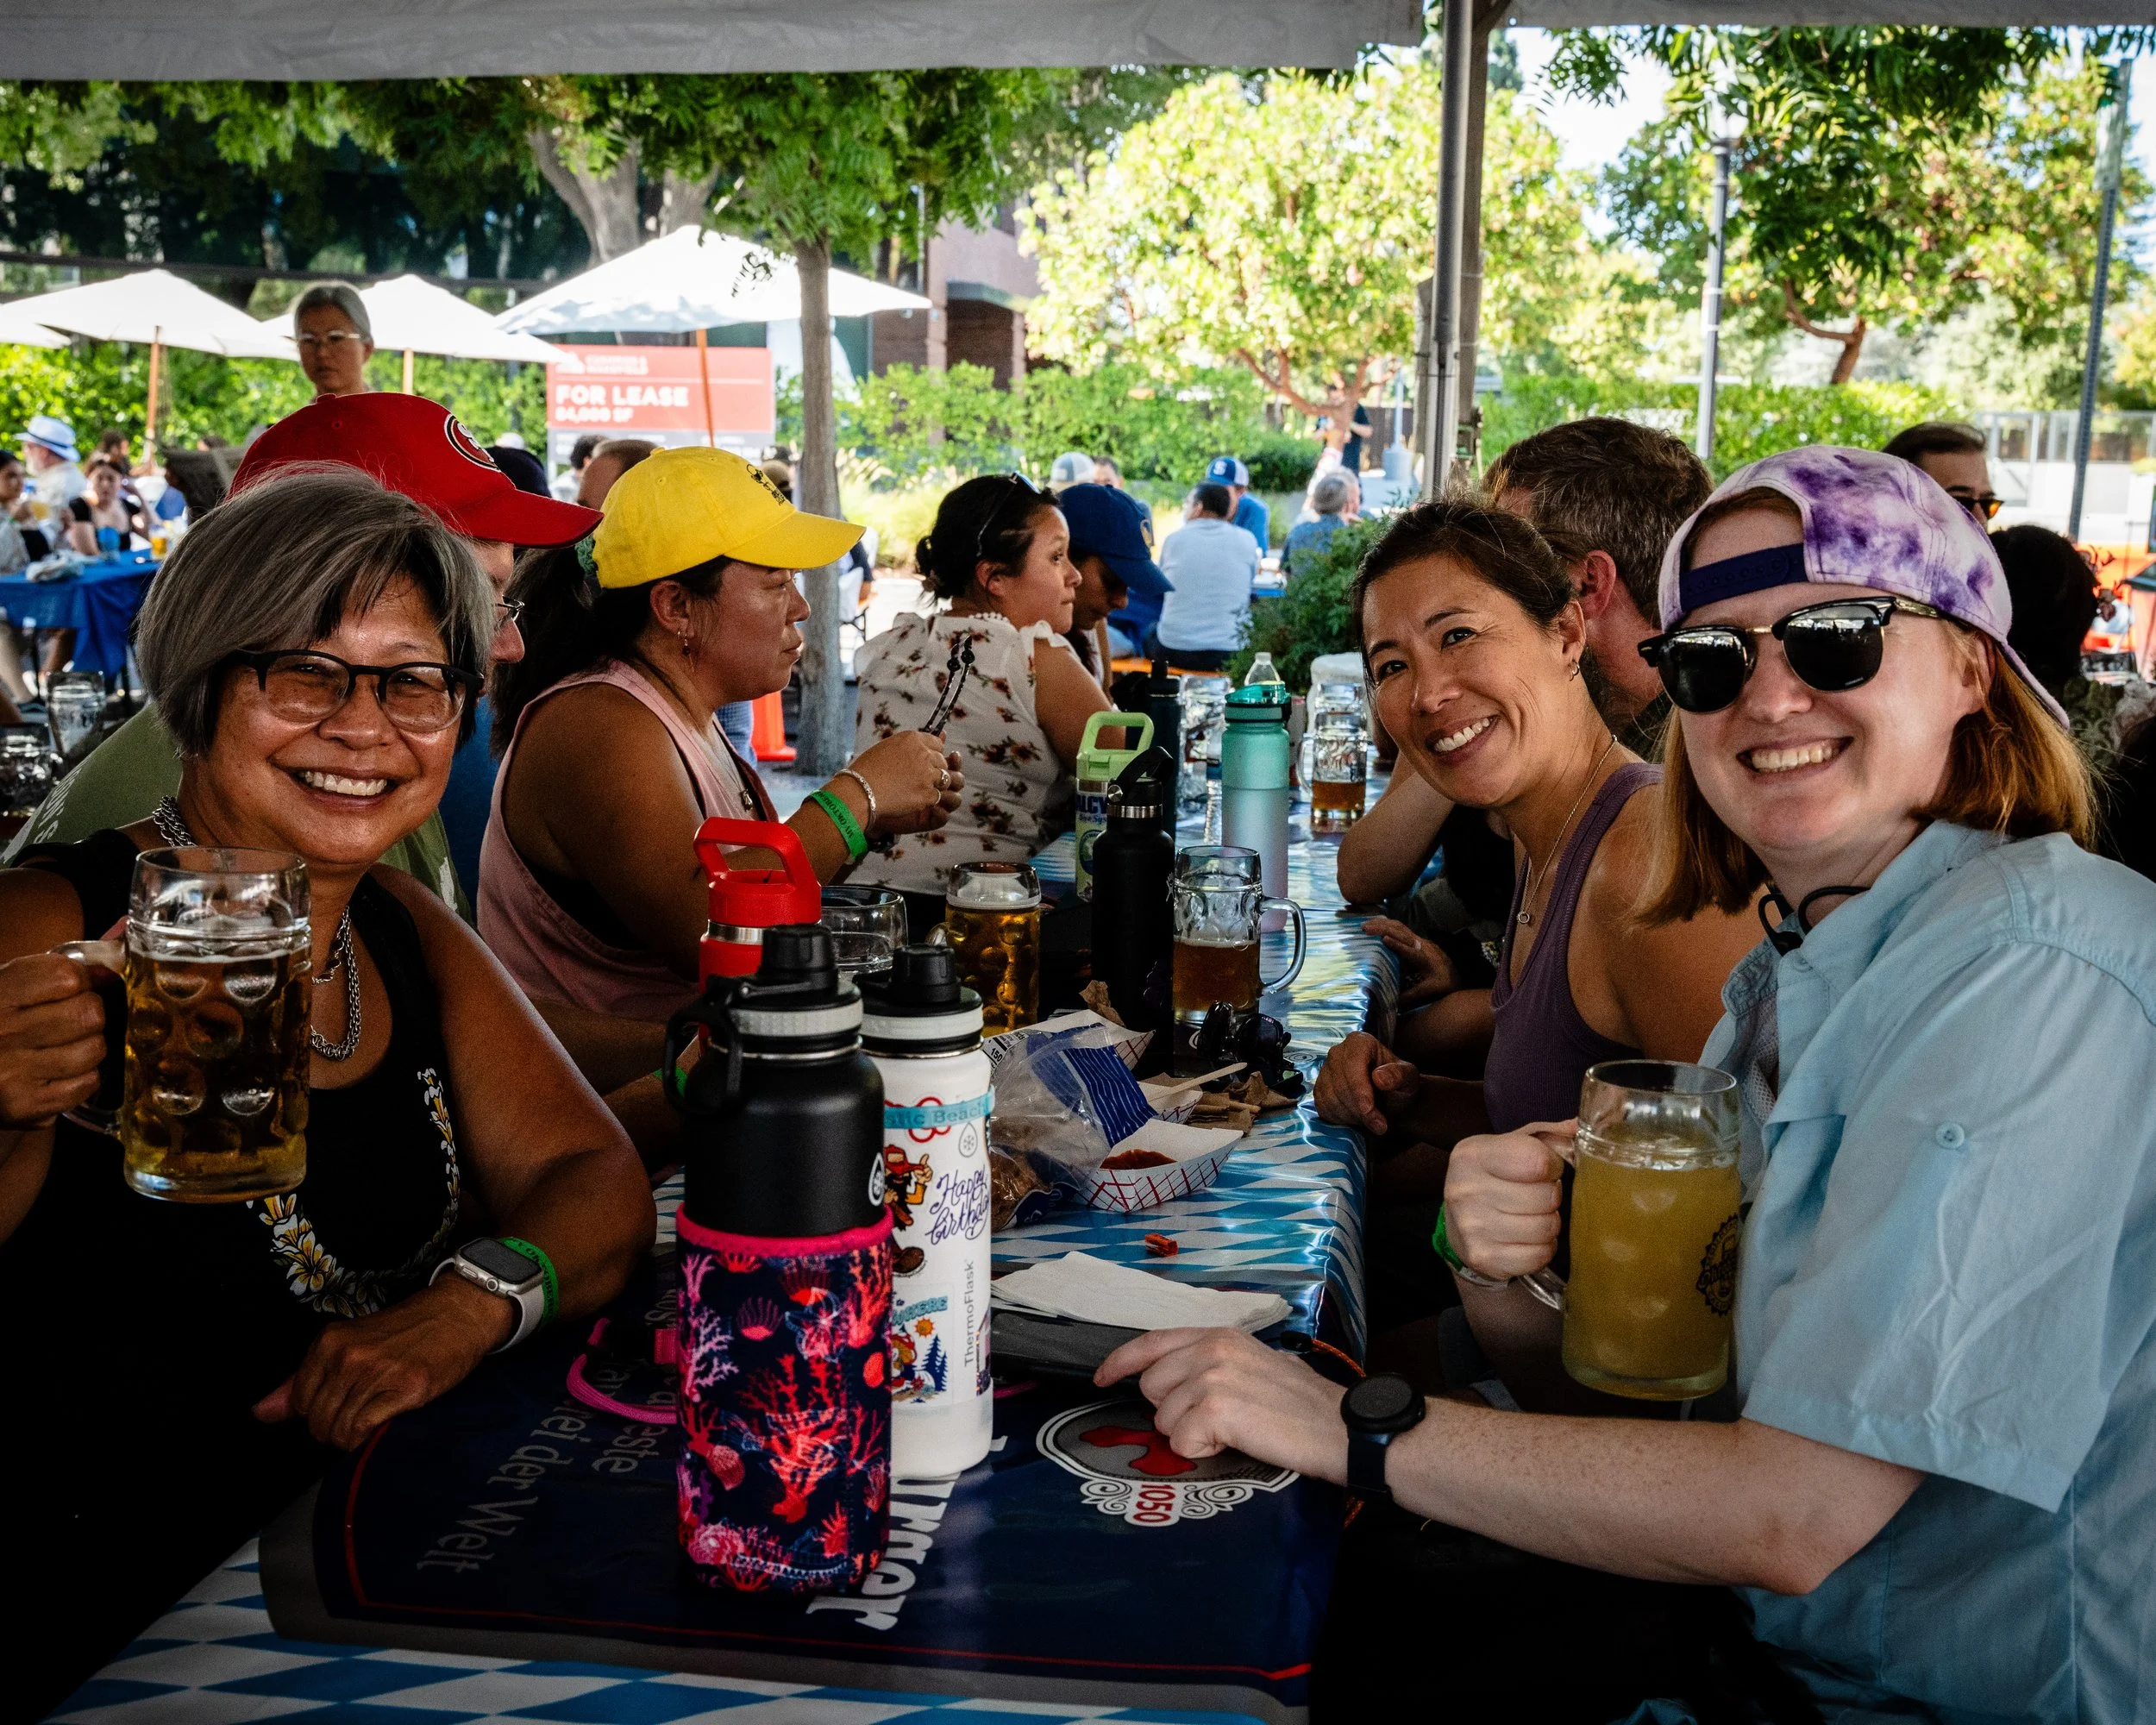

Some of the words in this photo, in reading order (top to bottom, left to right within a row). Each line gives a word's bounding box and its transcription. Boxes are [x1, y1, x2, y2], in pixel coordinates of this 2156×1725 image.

[556, 385, 606, 405] FOR
[612, 386, 689, 407] LEASE
[990, 1047, 1003, 1063] 150
[884, 1108, 926, 1126] stic
[933, 1098, 986, 1123] Beach
[930, 1164, 987, 1215] Happy
[892, 1295, 948, 1326] WHERE
[963, 1260, 975, 1368] ThermoFlask
[486, 1443, 575, 1491] der
[1132, 1484, 1176, 1524] 1050
[415, 1496, 540, 1575] Welt
